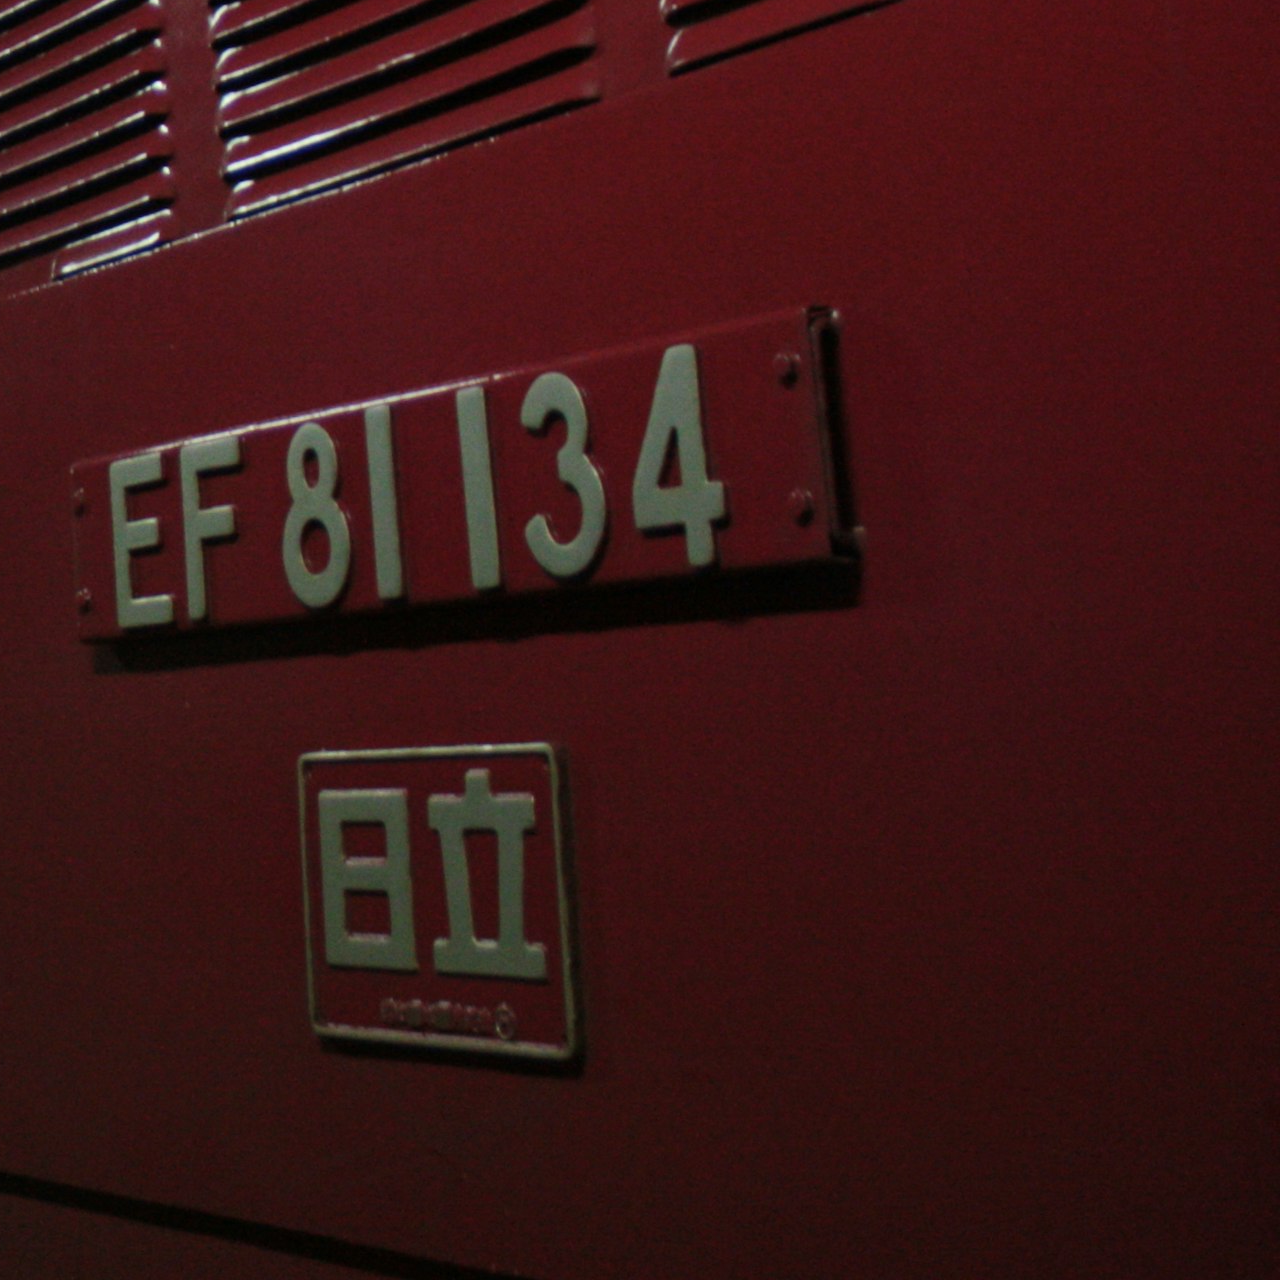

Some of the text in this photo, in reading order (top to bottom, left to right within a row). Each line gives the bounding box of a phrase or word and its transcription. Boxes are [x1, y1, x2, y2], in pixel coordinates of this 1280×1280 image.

[109, 342, 726, 628] EF 81 134
[318, 768, 548, 983] 日立
